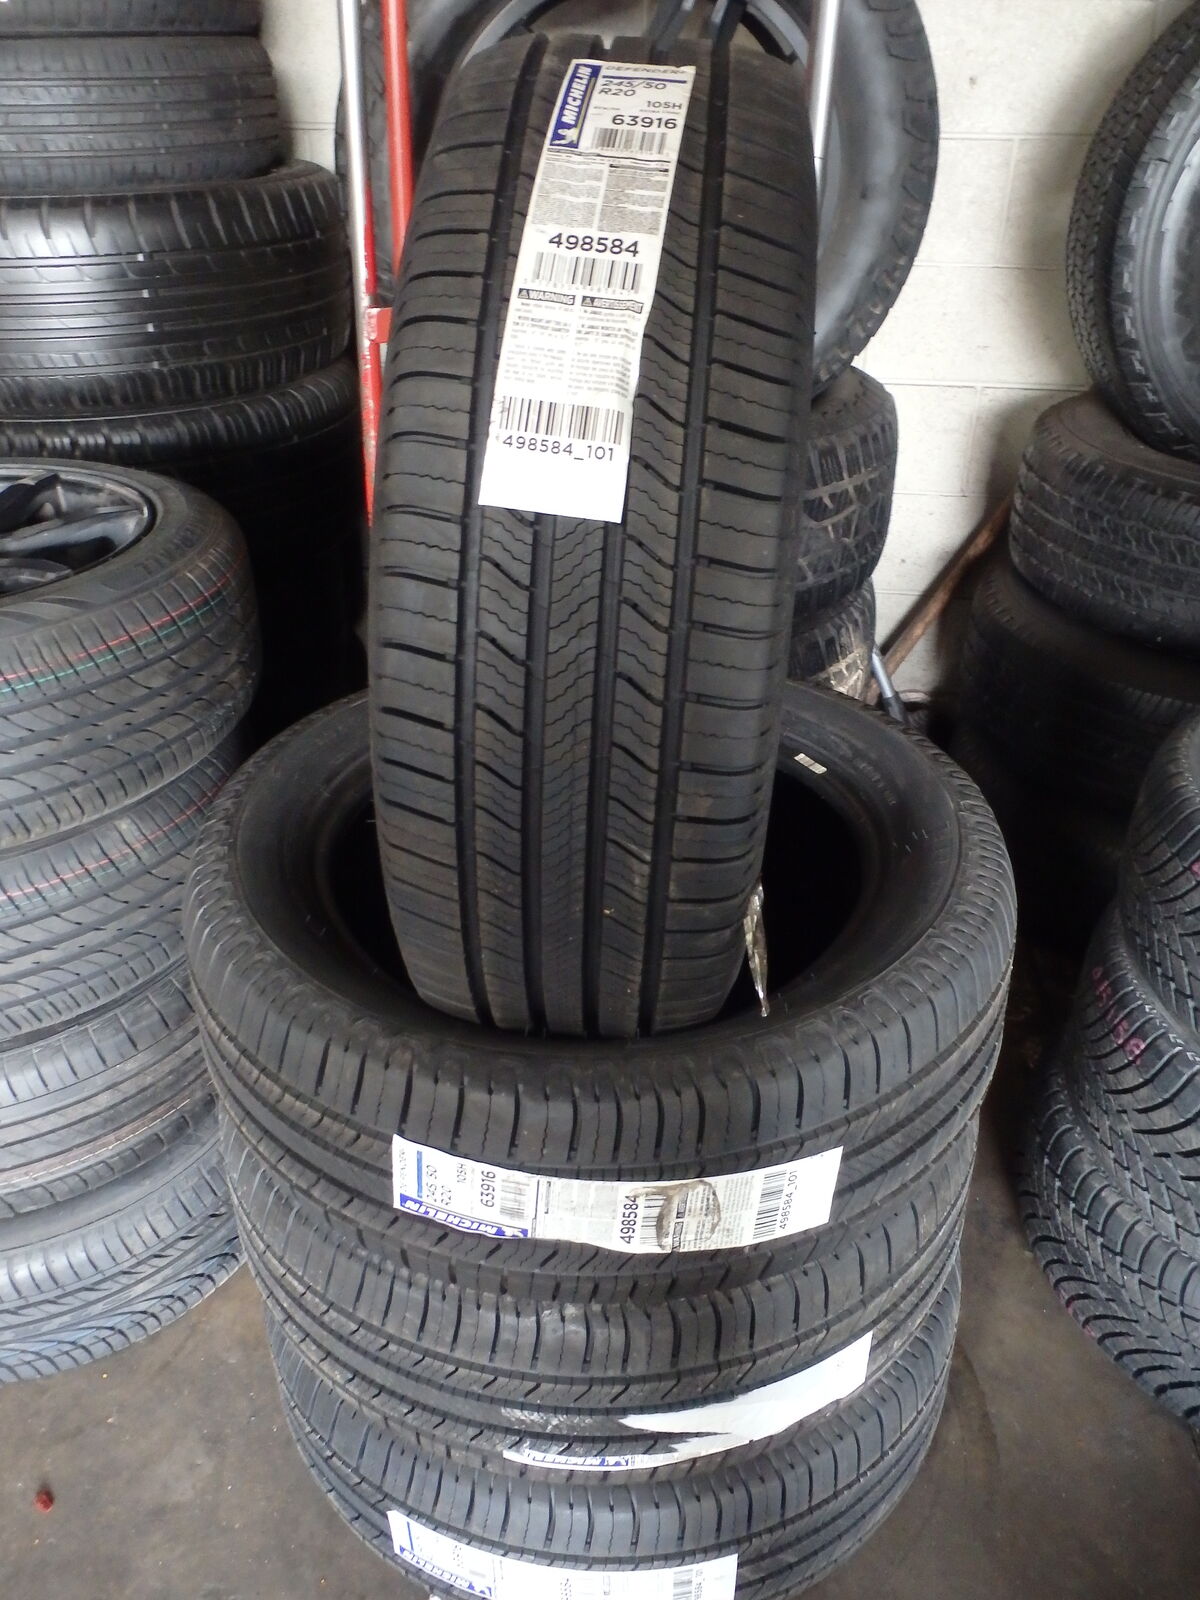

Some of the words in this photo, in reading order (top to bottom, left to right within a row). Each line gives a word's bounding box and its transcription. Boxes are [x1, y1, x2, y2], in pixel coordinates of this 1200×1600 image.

[561, 65, 592, 124] MICHELIN
[598, 88, 636, 97] R20
[601, 80, 667, 90] 245/50
[646, 100, 683, 110] 105H
[612, 114, 678, 130] 63916
[548, 232, 640, 258] 498584
[528, 290, 575, 305] WARNING
[502, 434, 615, 462] 498584_101
[480, 1169, 497, 1208] 63916
[779, 1170, 798, 1230] 498584_101
[404, 1199, 499, 1235] MICHELIN
[619, 1194, 640, 1245] 498584
